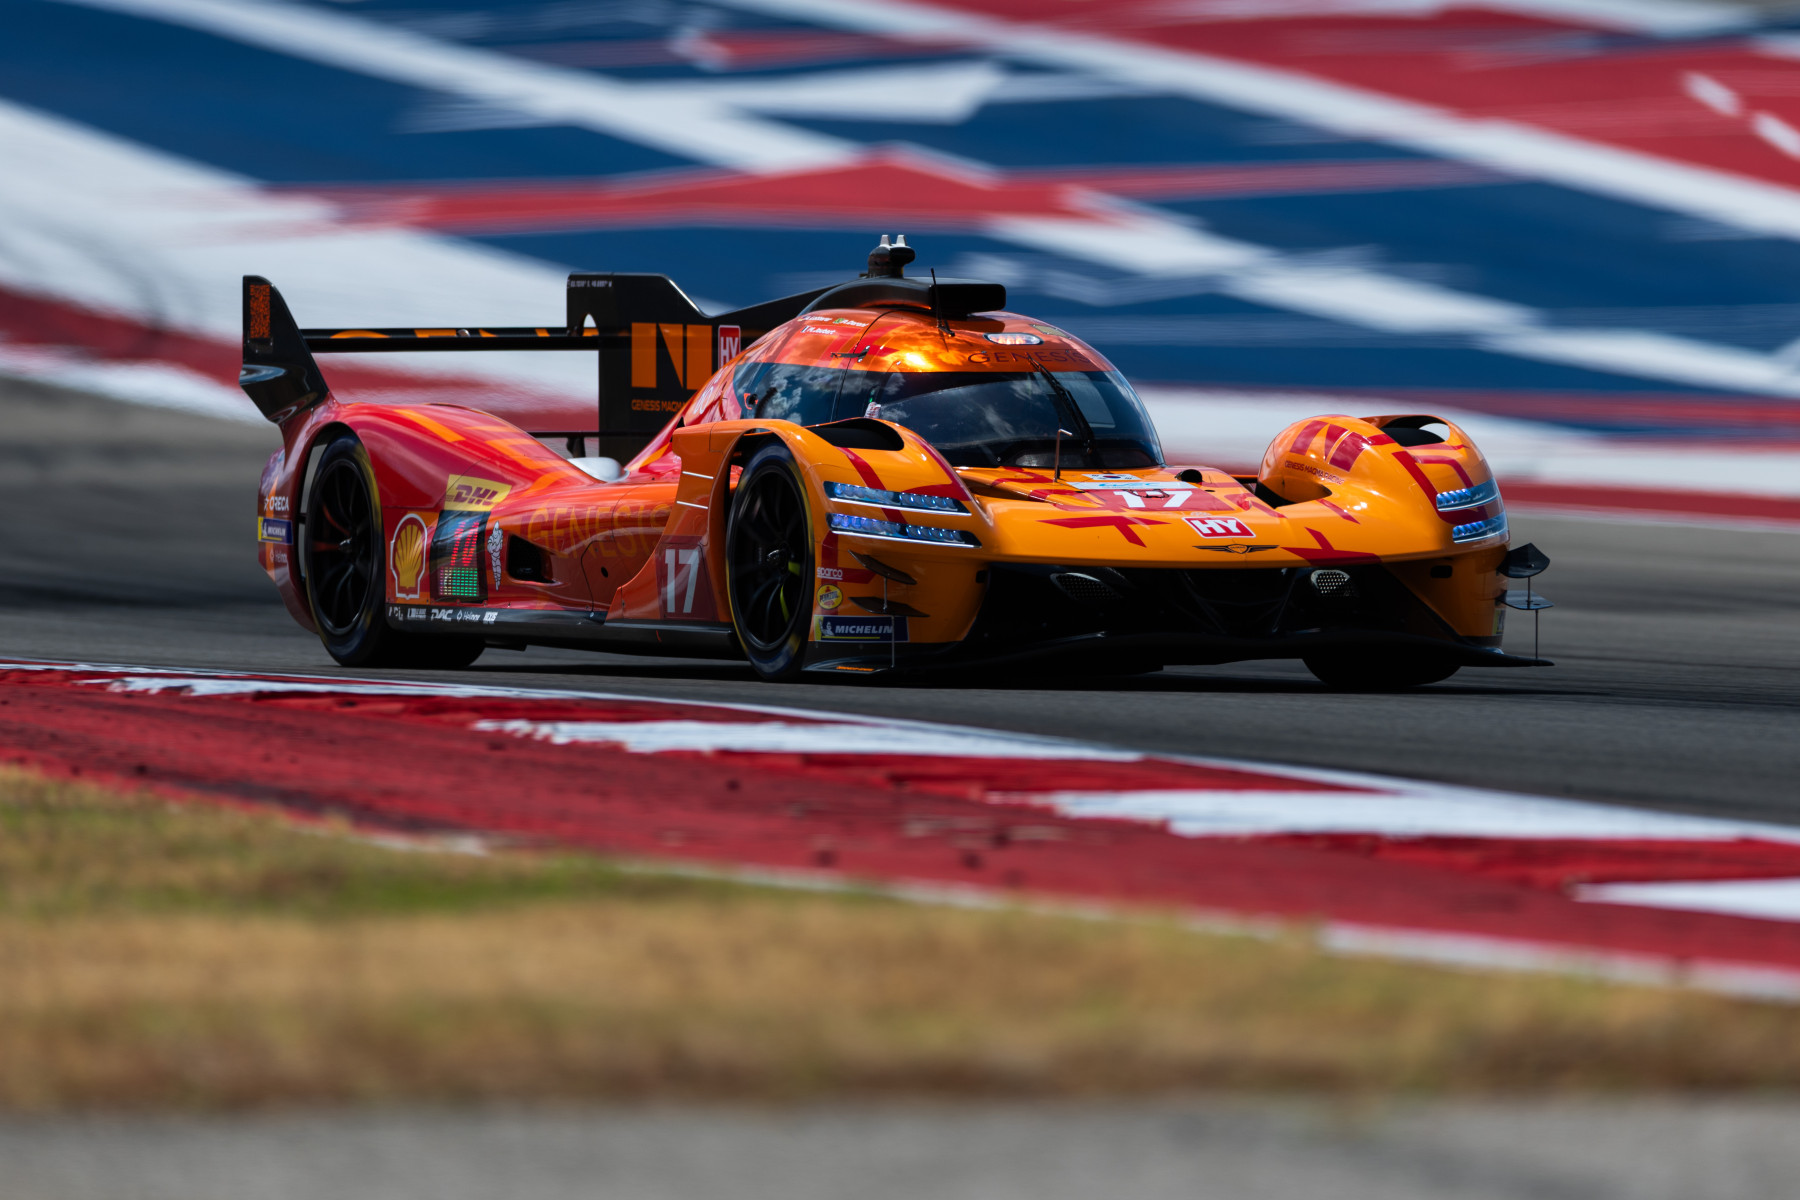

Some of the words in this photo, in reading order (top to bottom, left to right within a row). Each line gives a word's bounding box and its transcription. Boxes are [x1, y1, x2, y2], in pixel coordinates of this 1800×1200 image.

[968, 351, 1092, 364] GENESIS
[631, 399, 660, 411] GENESIS
[454, 484, 499, 506] DHL
[1113, 490, 1193, 508] 17
[269, 496, 290, 511] ORECA
[267, 526, 286, 537] MICHELIN
[1190, 519, 1242, 534] HY
[816, 566, 843, 580] sparco
[665, 549, 699, 613] 17
[835, 625, 893, 634] MICHELIN
